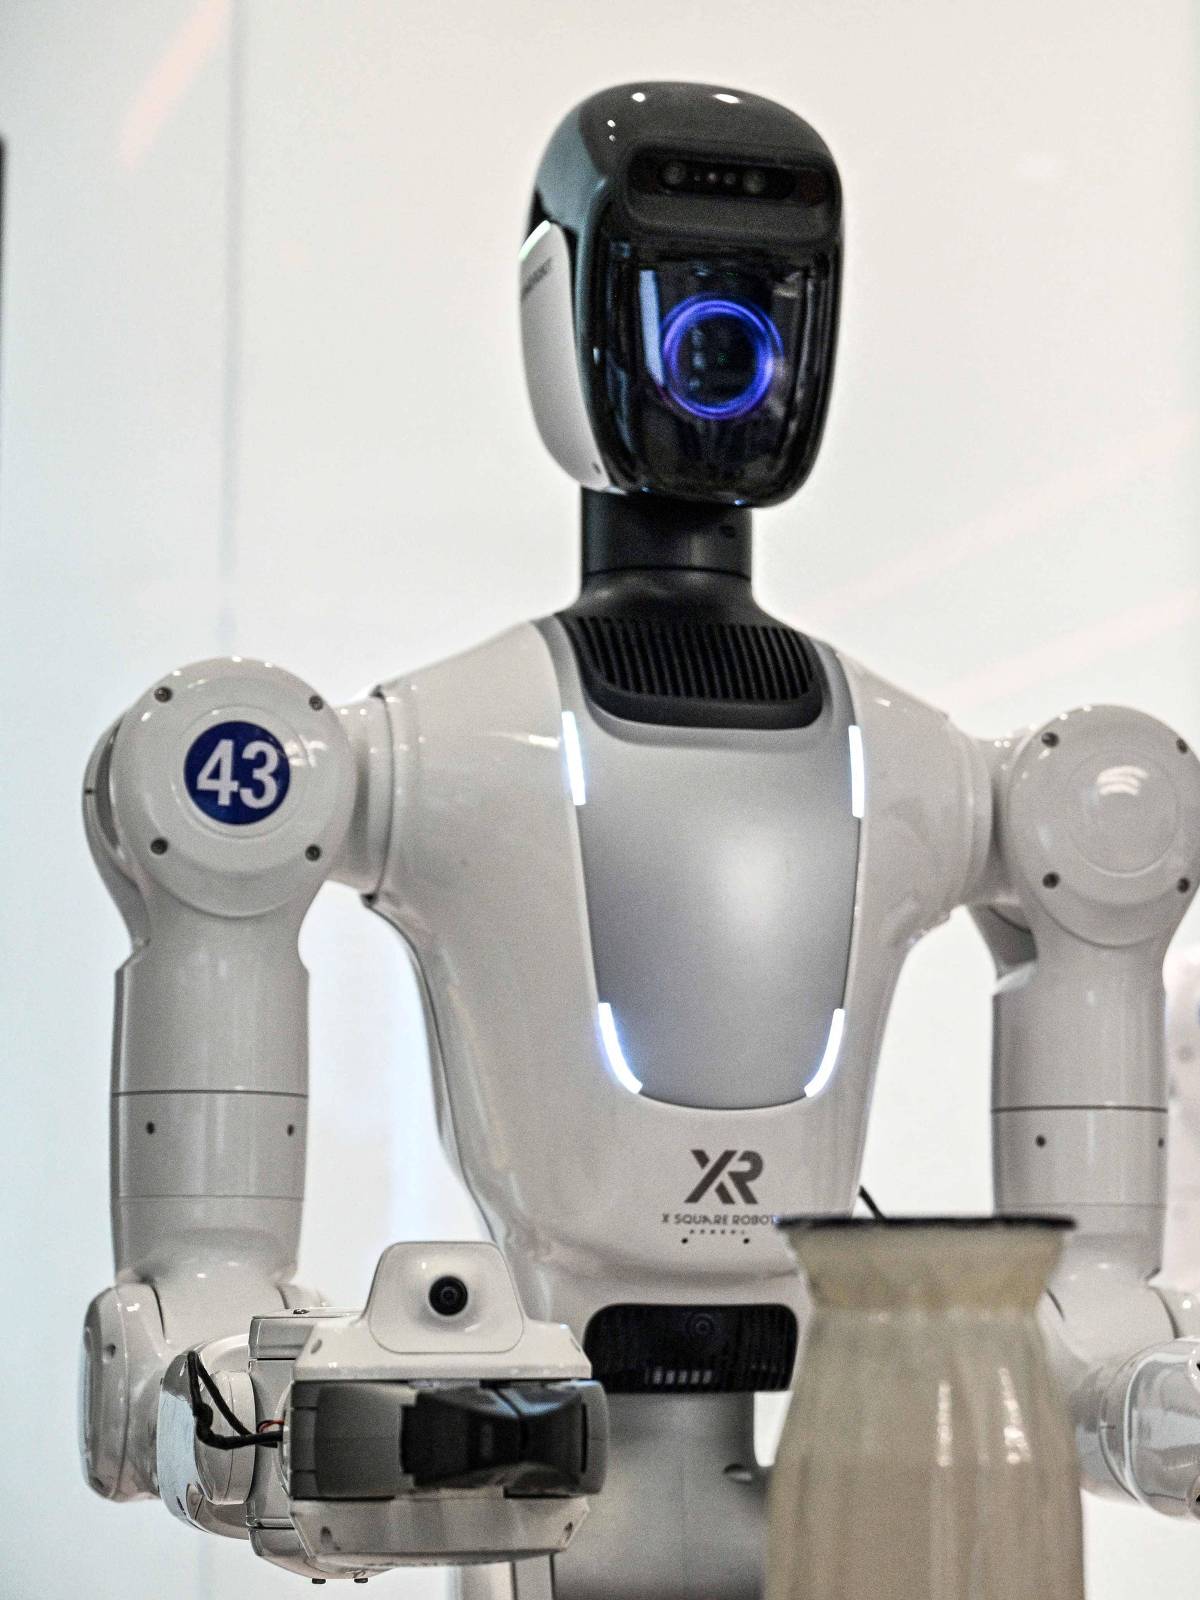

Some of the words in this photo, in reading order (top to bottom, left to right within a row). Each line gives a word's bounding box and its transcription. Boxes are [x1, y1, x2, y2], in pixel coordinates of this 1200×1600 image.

[196, 738, 279, 809] 43
[684, 1149, 764, 1205] XR
[674, 1213, 729, 1225] SQUARE
[732, 1214, 774, 1225] ROBO
